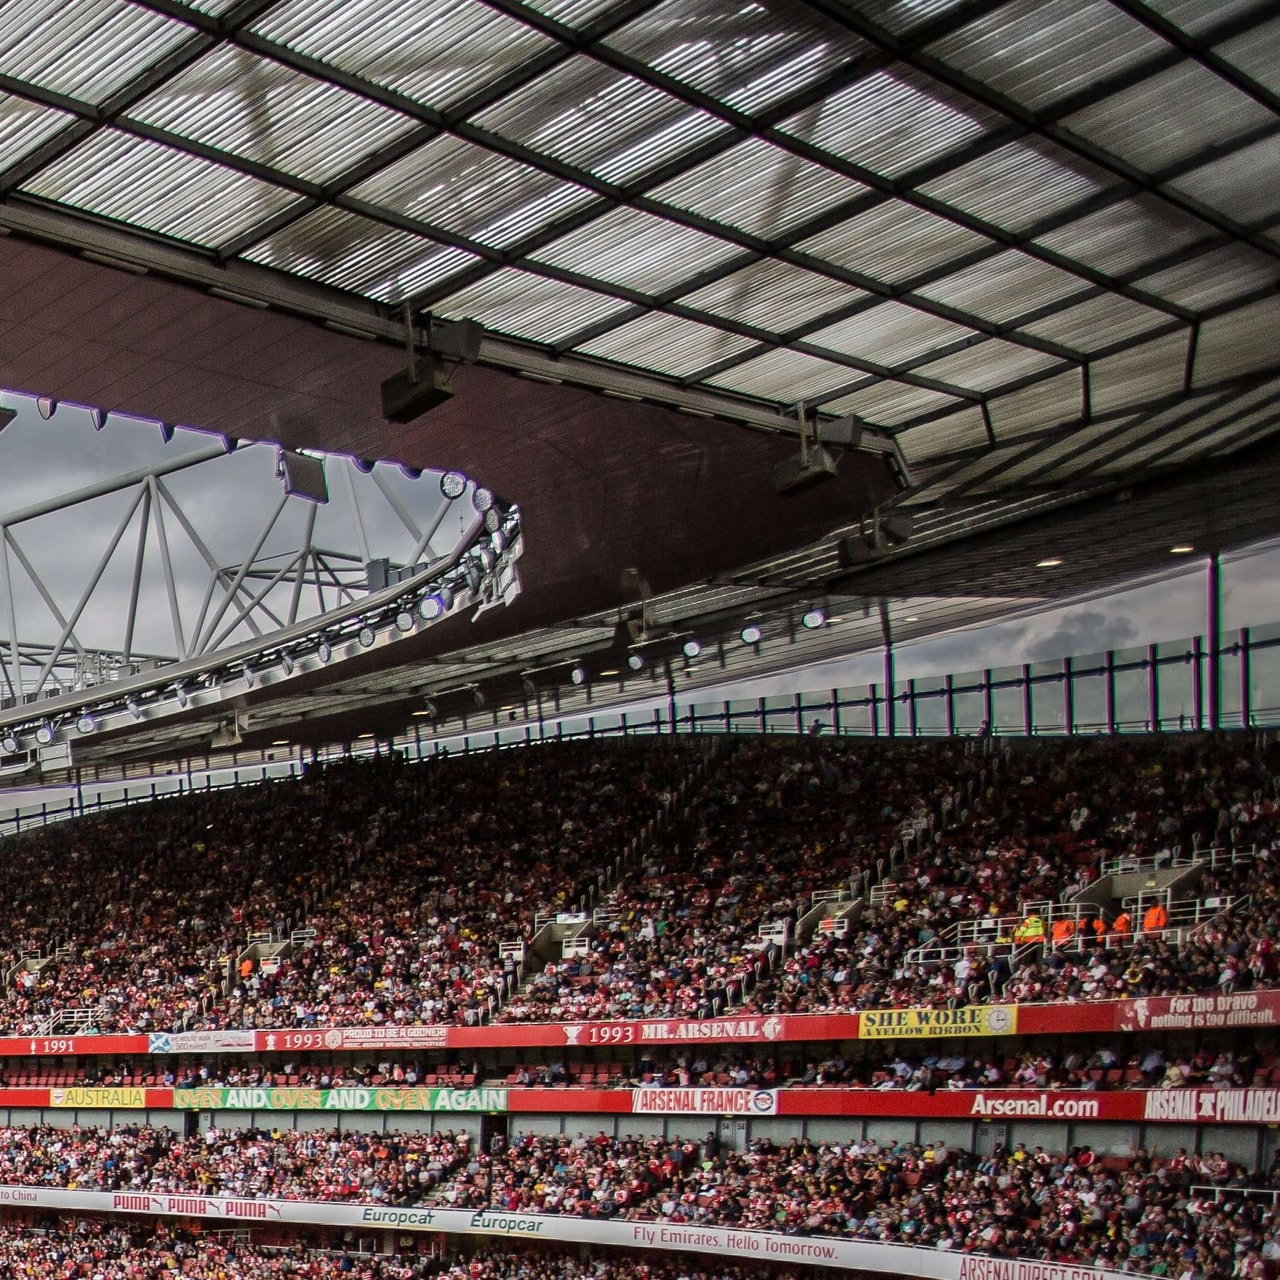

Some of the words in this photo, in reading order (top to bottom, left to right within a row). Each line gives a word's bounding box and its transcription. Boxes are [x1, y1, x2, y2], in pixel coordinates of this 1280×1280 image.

[1170, 997, 1191, 1013] For
[1217, 995, 1258, 1011] brave
[865, 1011, 908, 1027] SHE
[917, 1009, 982, 1026] WORE
[1151, 1013, 1193, 1028] nothing
[1194, 1012, 1204, 1026] is
[1206, 1013, 1225, 1026] too
[343, 1029, 373, 1038] PROUD
[374, 1029, 385, 1038] TO
[386, 1029, 399, 1038] BE
[589, 1027, 633, 1042] 1993
[876, 1027, 924, 1036] YELLOW
[929, 1025, 982, 1035] RIBBON
[43, 1040, 74, 1052] 1991
[284, 1034, 323, 1048] 1993
[65, 1089, 143, 1105] AUSTRALIA
[177, 1089, 222, 1108] OVER
[225, 1089, 268, 1109] AND
[271, 1089, 322, 1108] OVER
[325, 1089, 370, 1109] AND
[375, 1089, 431, 1109] OVER
[434, 1089, 507, 1110] AGAIN
[641, 1090, 697, 1111] ARSENAL
[700, 1090, 751, 1111] FRANCE
[971, 1094, 1098, 1117] Arsenal.com
[1144, 1090, 1197, 1120] ARSENAL
[1216, 1090, 1280, 1121] PHILADEL
[1, 1190, 9, 1200] to
[12, 1190, 38, 1202] China
[113, 1195, 151, 1211] PUMA
[168, 1198, 207, 1214] PUMA
[226, 1201, 266, 1218] PUMA
[470, 1212, 543, 1233] Europcar
[633, 1226, 654, 1244] Fly
[660, 1228, 722, 1248] Emirates.
[726, 1234, 759, 1251] Hello
[764, 1238, 839, 1260] Tomorrow.
